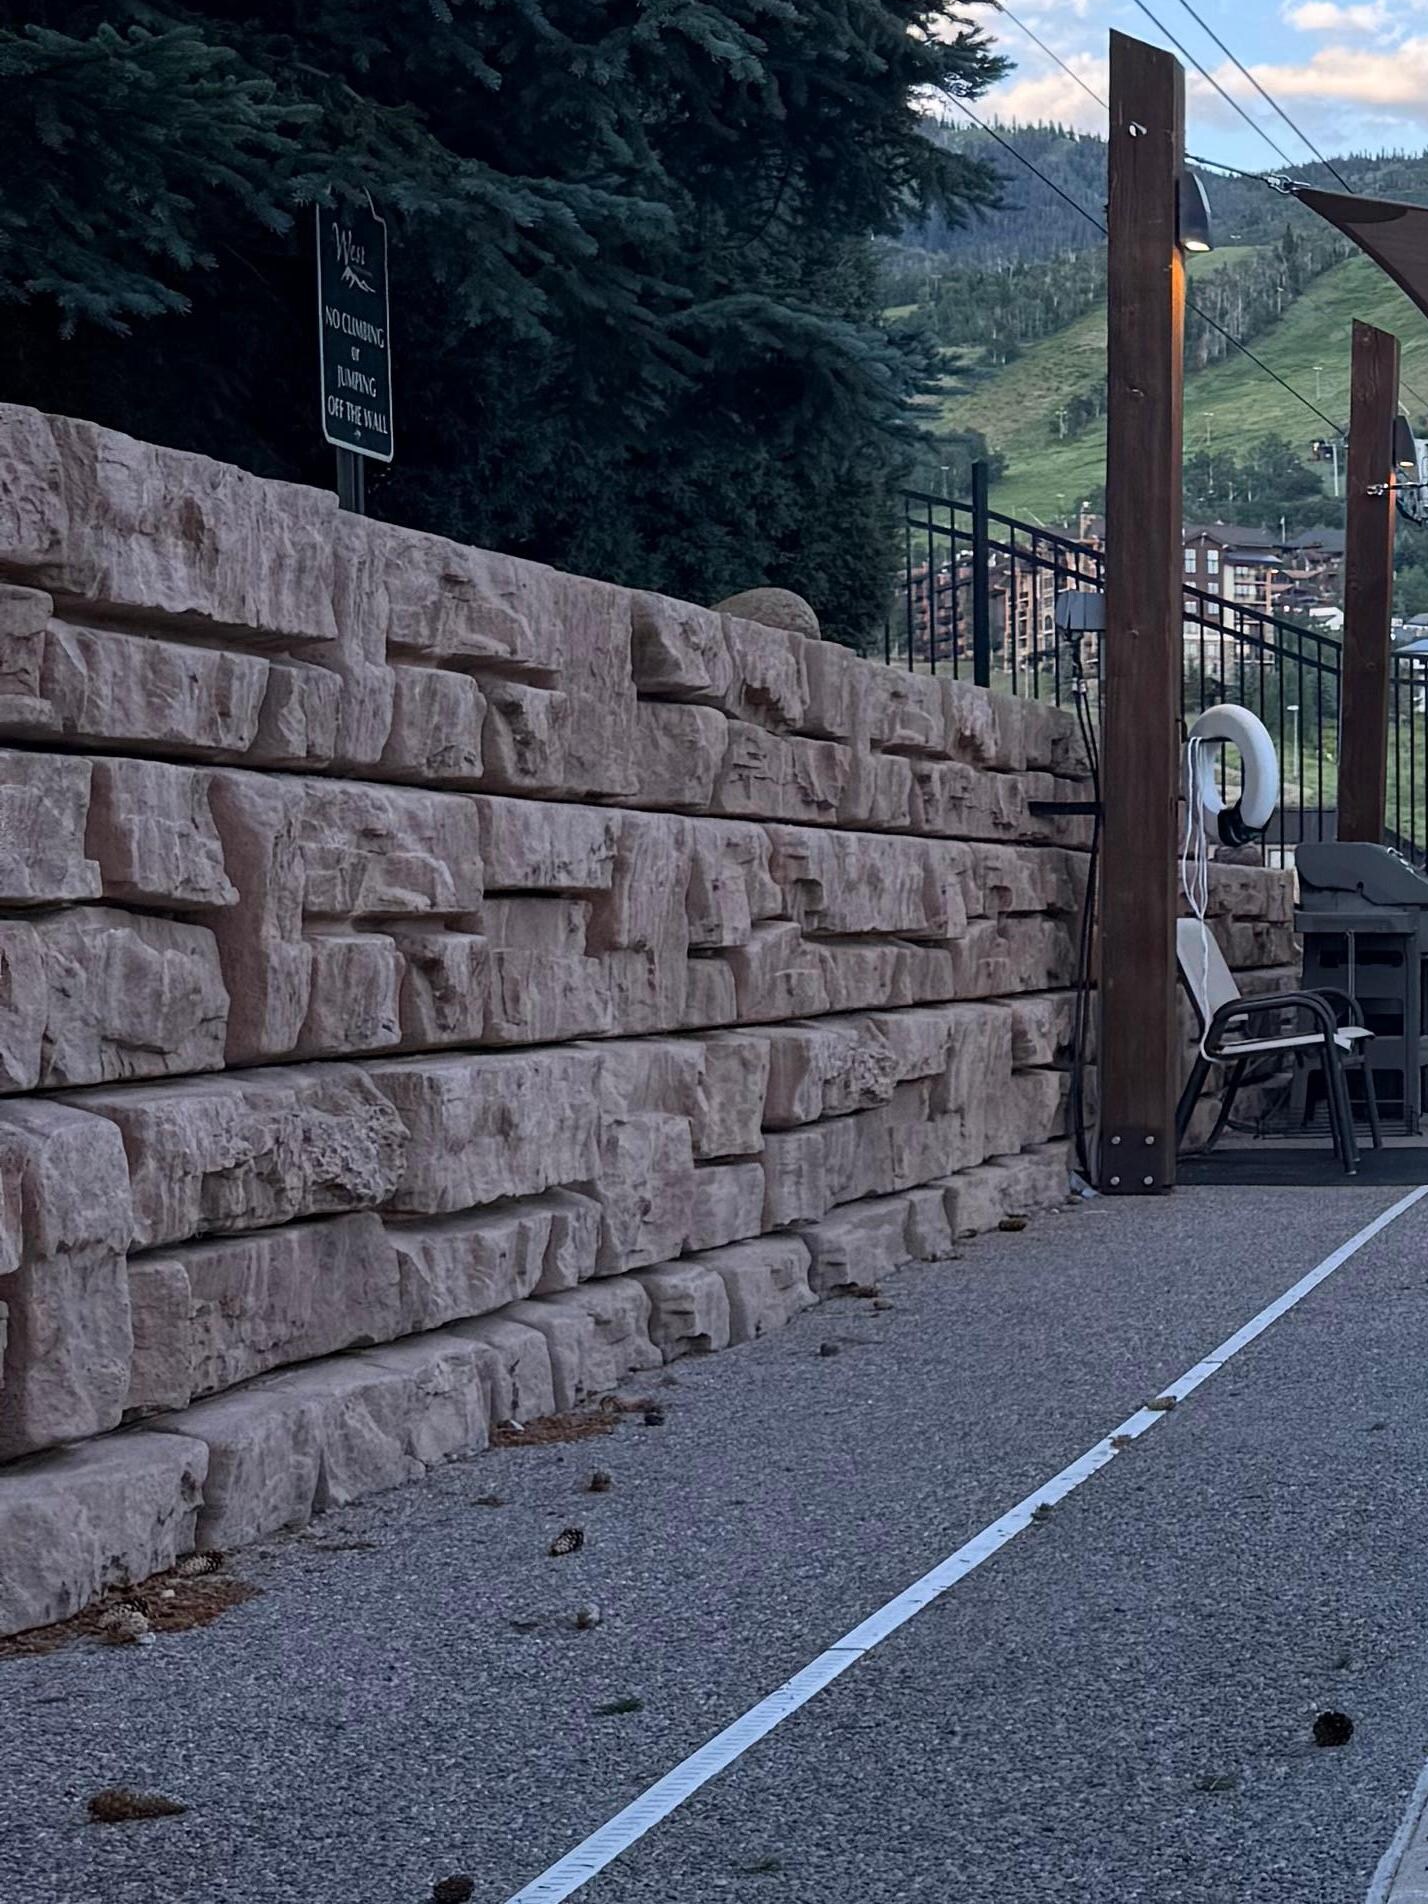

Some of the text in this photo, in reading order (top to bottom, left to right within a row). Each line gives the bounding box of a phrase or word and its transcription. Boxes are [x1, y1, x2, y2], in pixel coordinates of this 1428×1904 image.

[332, 222, 366, 266] West
[326, 305, 384, 348] NO CLIMBING
[337, 364, 377, 398] JUMPING
[328, 395, 389, 435] OFF THE WALL
